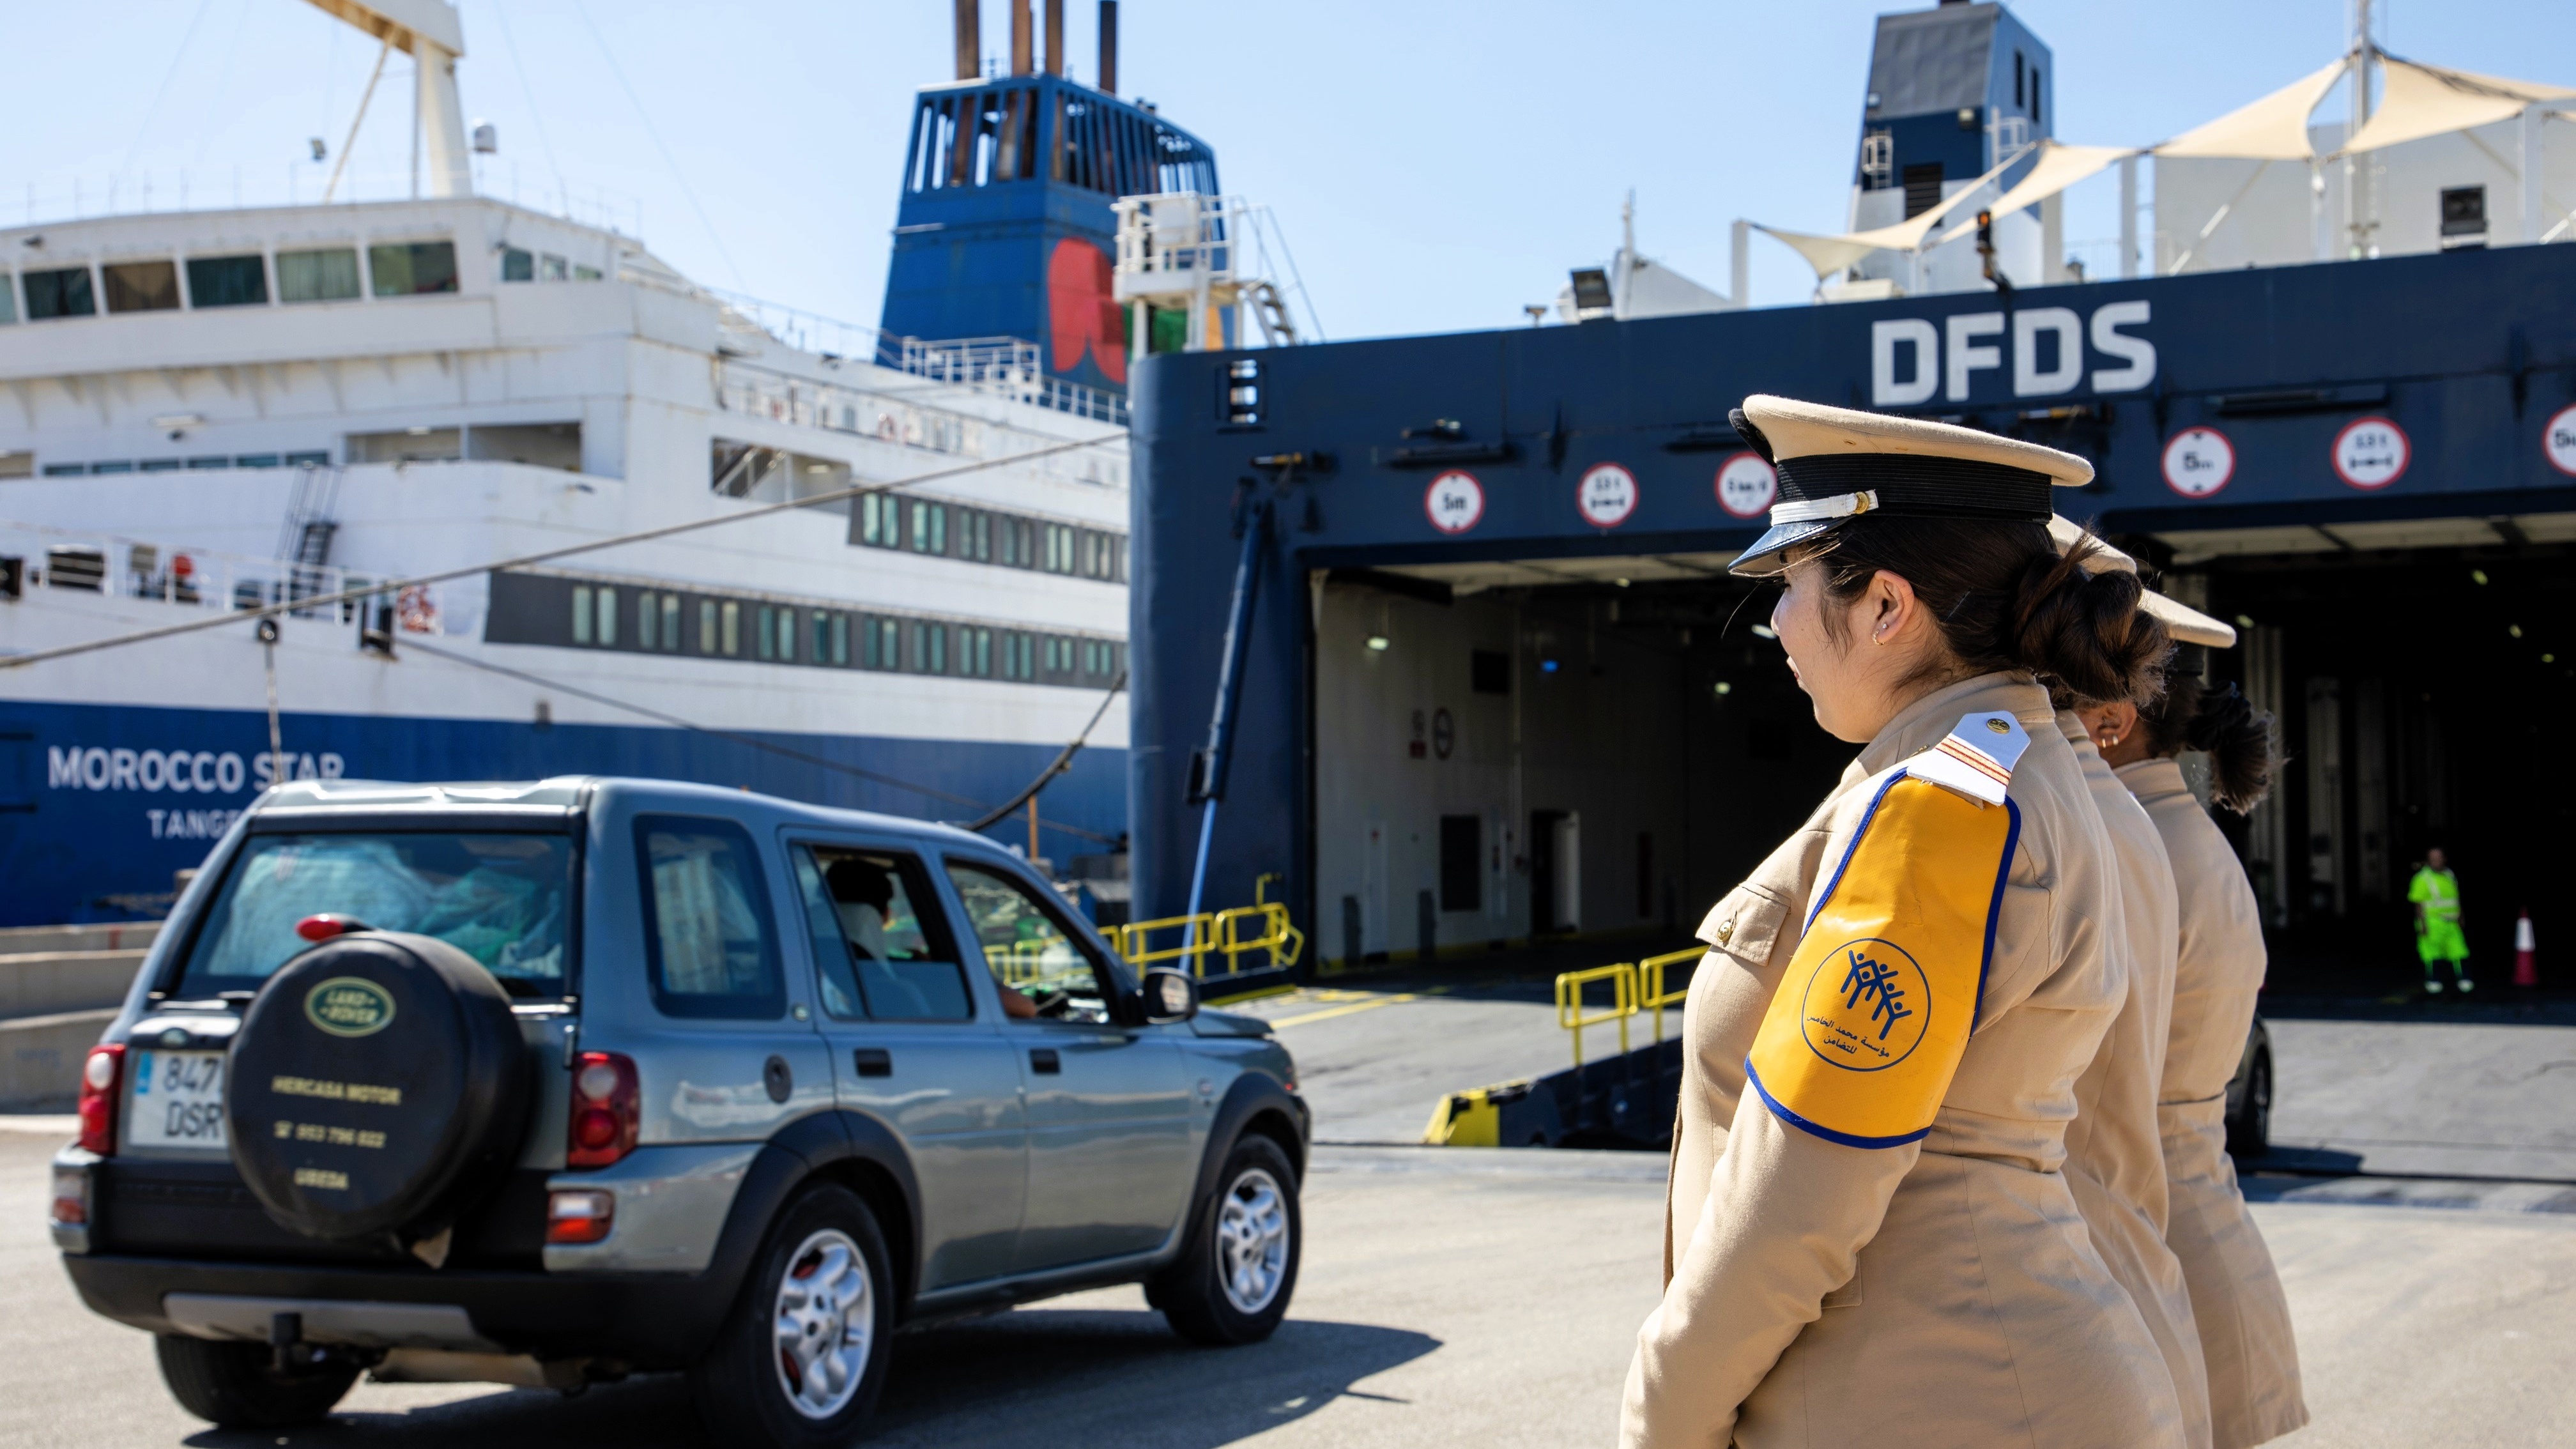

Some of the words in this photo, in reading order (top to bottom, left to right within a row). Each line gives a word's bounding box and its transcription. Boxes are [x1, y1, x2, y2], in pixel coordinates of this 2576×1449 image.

[1872, 300, 2157, 406] DFDS
[48, 745, 245, 793] MOROCCO
[253, 751, 344, 792] STAR
[1806, 1015, 1834, 1028] الخامس
[1836, 1025, 1858, 1041] محمد
[1823, 1035, 1857, 1054] للتضامن
[1860, 1036, 1890, 1057] مؤسسة
[163, 1055, 224, 1093] 847
[346, 1083, 402, 1106] MOTOR
[164, 1100, 224, 1139] DSR
[294, 1167, 349, 1190] UBEDA
